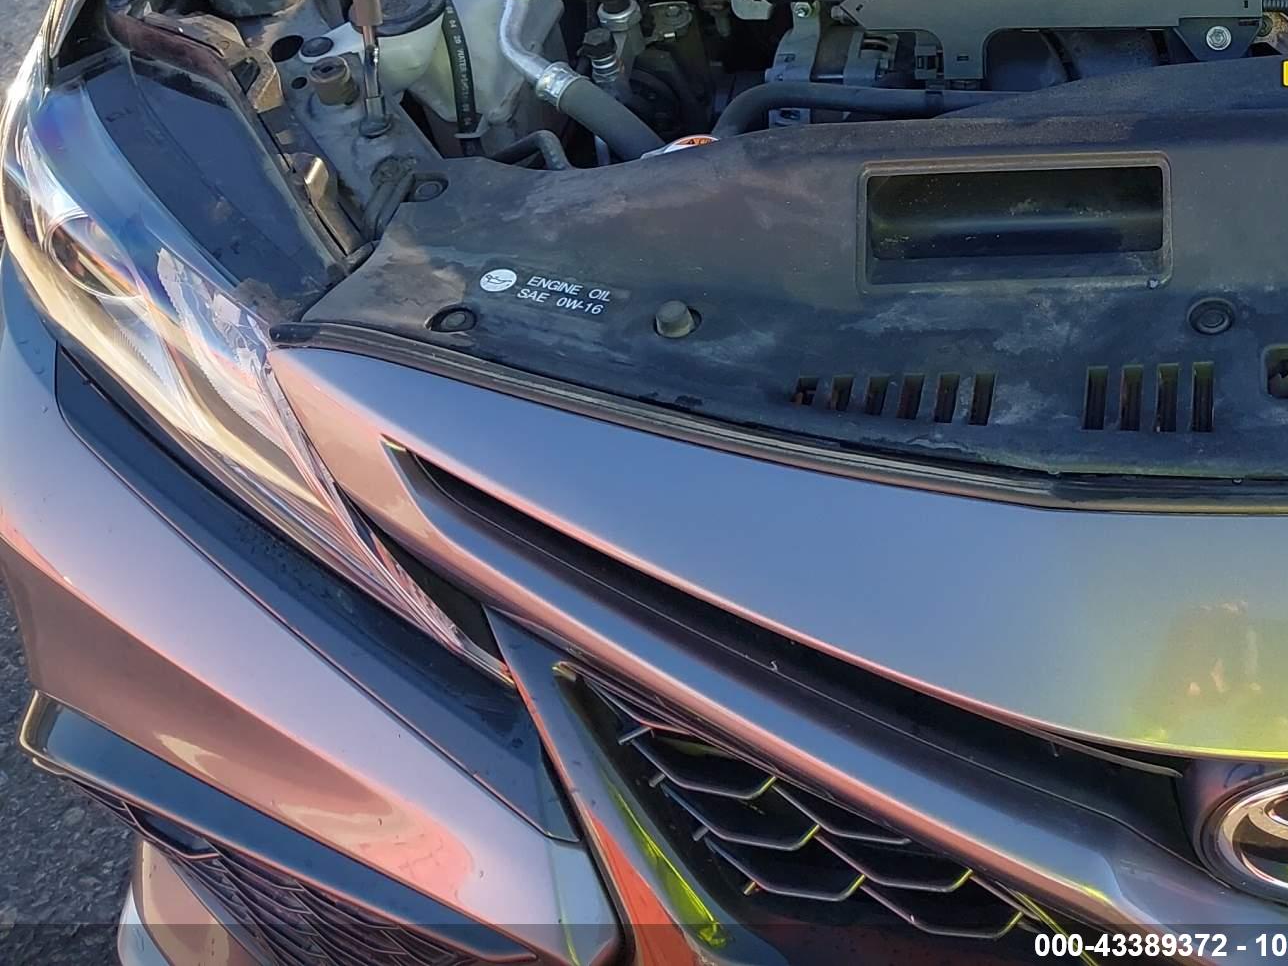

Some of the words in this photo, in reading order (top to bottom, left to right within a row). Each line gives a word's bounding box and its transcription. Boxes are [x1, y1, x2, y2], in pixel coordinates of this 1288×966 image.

[517, 288, 550, 303] SAE
[556, 296, 604, 315] 0W-16
[526, 275, 583, 296] ENGINE
[588, 288, 612, 302] OIL
